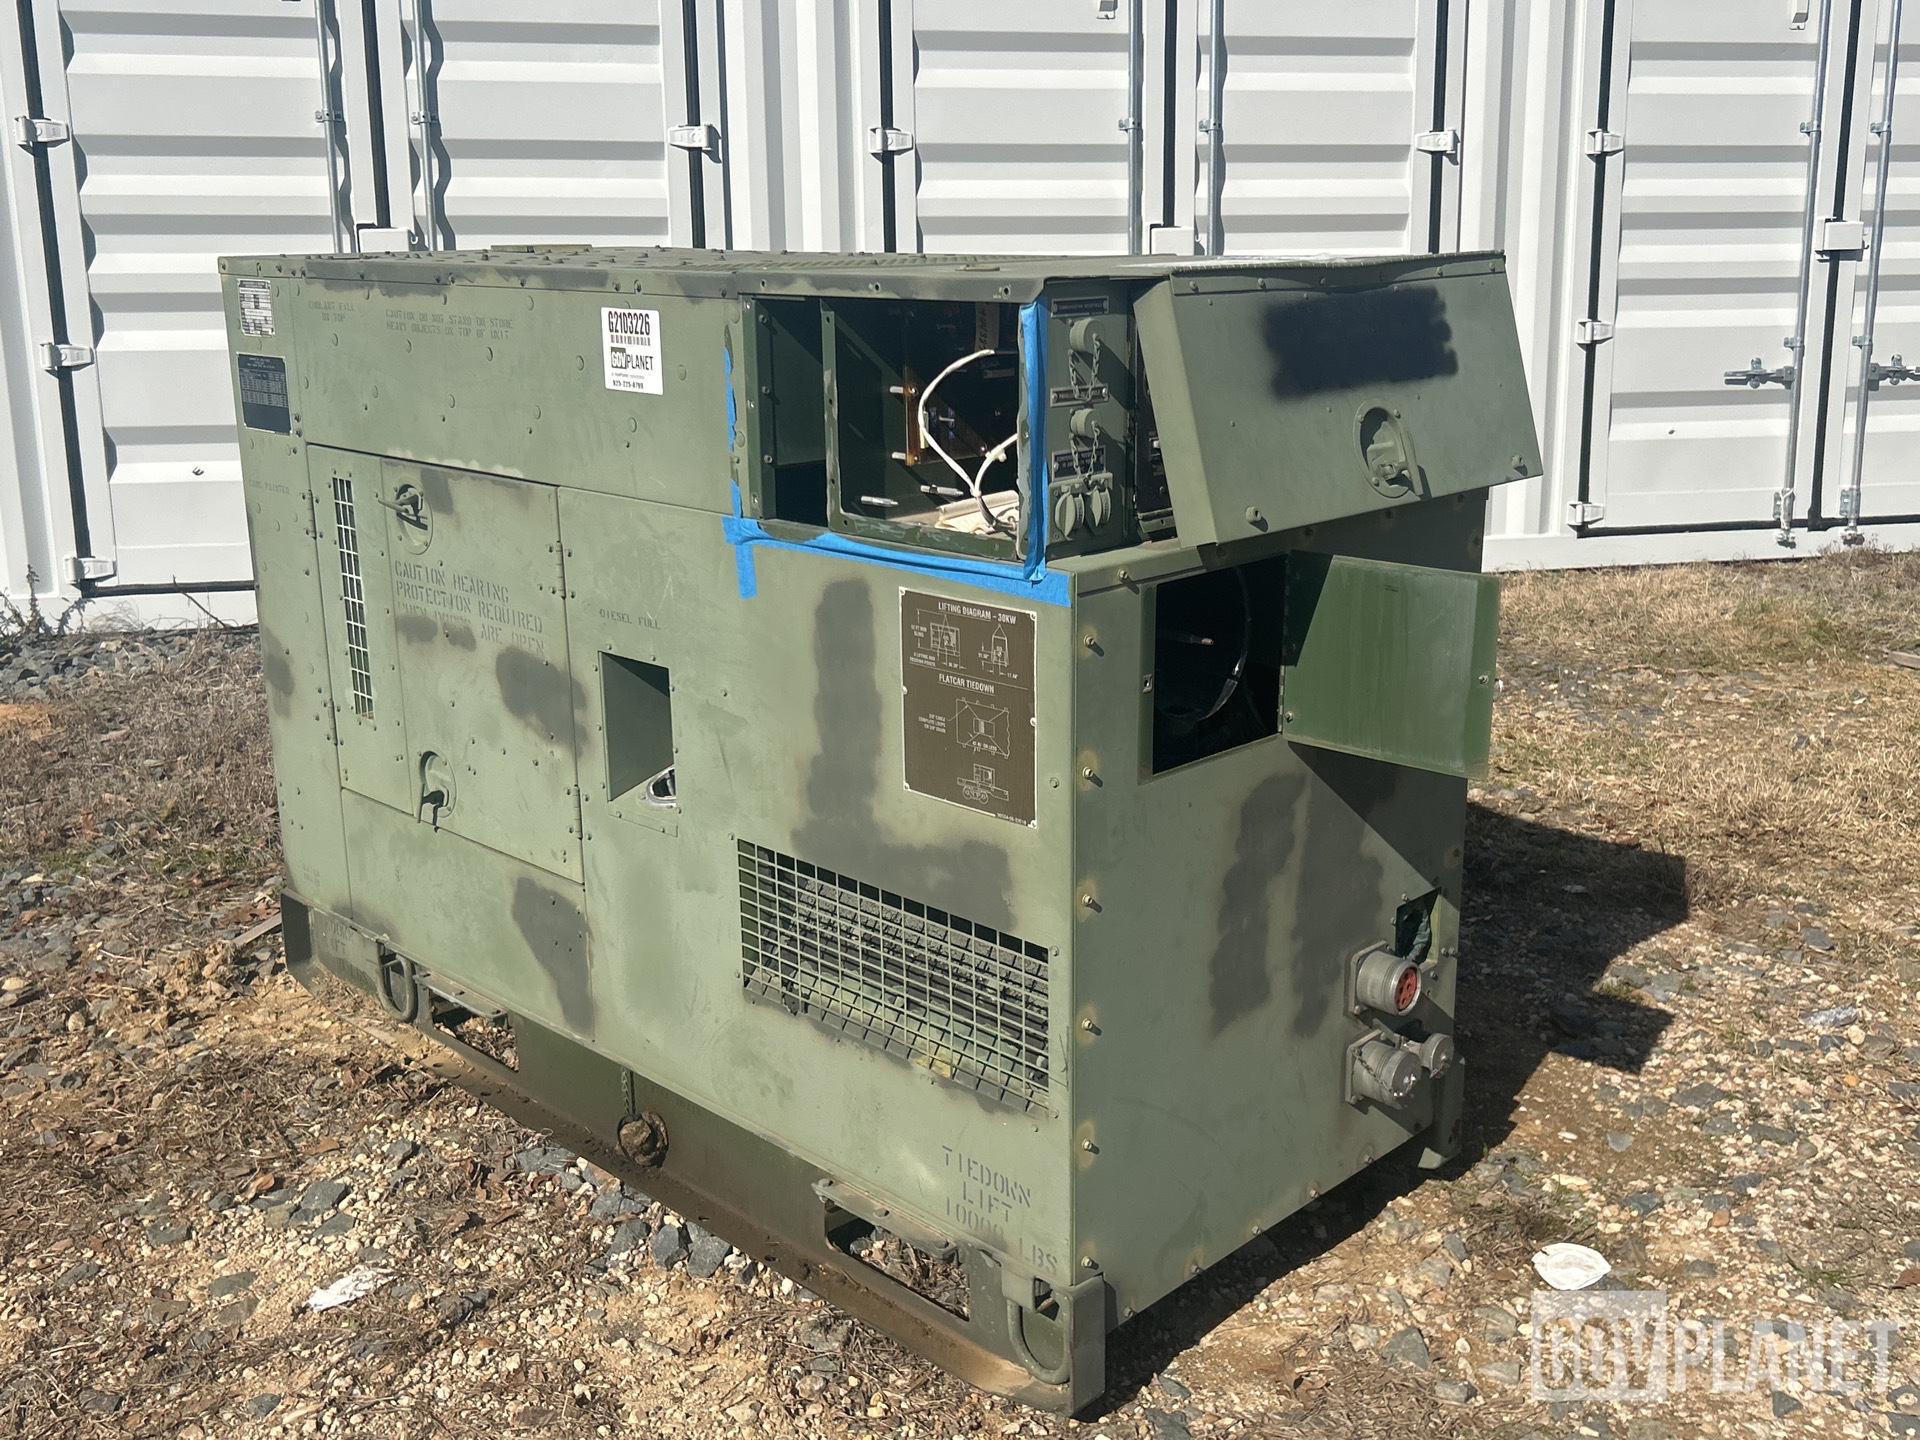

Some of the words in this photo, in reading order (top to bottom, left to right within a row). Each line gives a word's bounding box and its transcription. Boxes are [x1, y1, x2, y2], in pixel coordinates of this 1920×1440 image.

[333, 313, 346, 322] TOP
[339, 302, 355, 312] FILL
[385, 309, 416, 321] CAUTION
[419, 313, 428, 322] DO
[431, 313, 444, 323] NOT
[449, 315, 472, 327] STAND
[476, 316, 486, 327] OR
[490, 318, 513, 329] STORE
[386, 320, 407, 332] HEAVY
[411, 322, 441, 335] OBJECTS
[445, 326, 454, 337] ON
[458, 327, 472, 337] TOP
[476, 329, 485, 339] OF
[490, 329, 509, 340] UNIT
[608, 310, 651, 336] G2103226
[611, 349, 654, 371] GOVPLANET
[395, 560, 446, 587] CAUTION
[452, 573, 510, 604] HEARING
[396, 579, 472, 614] PROTECTION
[478, 600, 543, 634] REQUIRED
[938, 602, 962, 614] LIFTING
[962, 606, 992, 620] DIAGRAM
[997, 613, 1017, 625] 30KW
[599, 608, 633, 624] DIESEL
[638, 616, 661, 631] FUEL
[480, 623, 504, 645] ARE
[511, 631, 545, 659] OPEN
[938, 673, 965, 688] FLATCAR
[966, 679, 995, 694] TIEDOWN
[942, 1145, 1031, 1208] TIEDOWN
[963, 1181, 1012, 1223] LIFT
[1019, 1237, 1058, 1275] LBS
